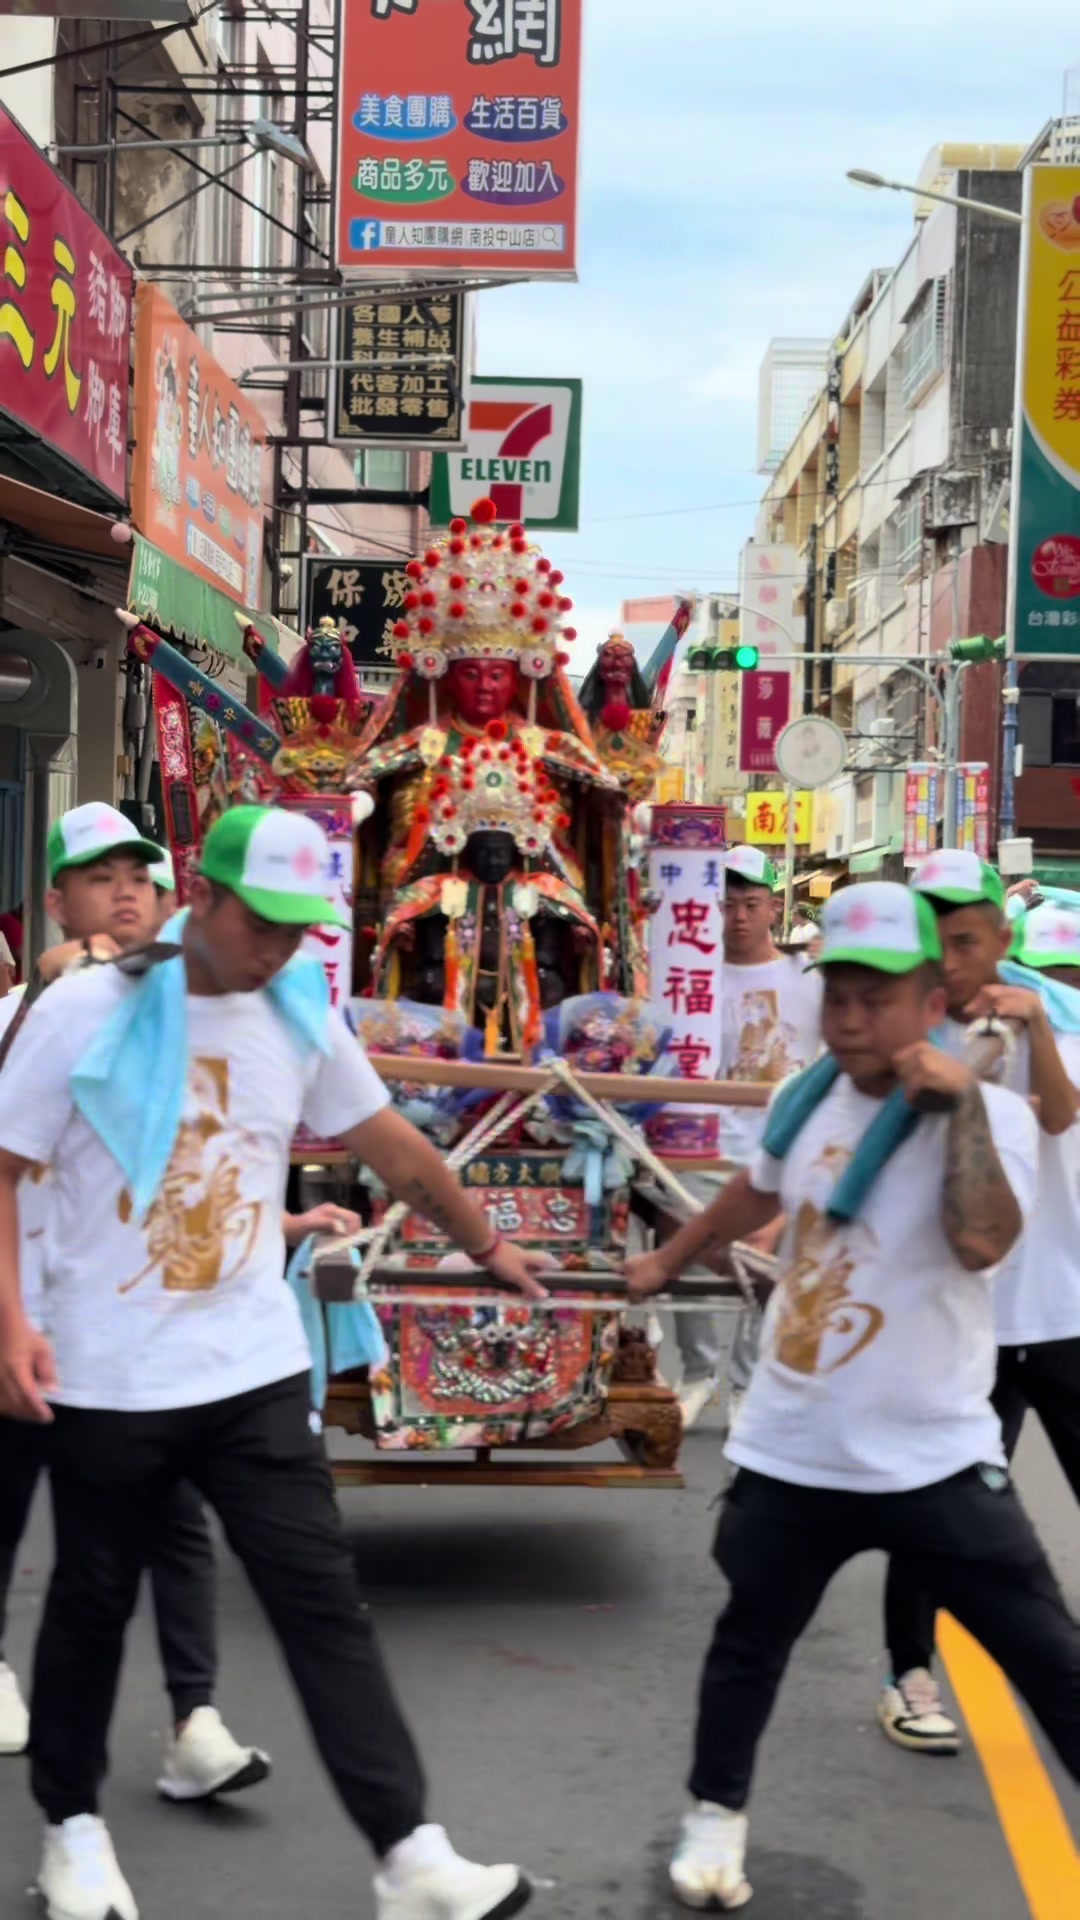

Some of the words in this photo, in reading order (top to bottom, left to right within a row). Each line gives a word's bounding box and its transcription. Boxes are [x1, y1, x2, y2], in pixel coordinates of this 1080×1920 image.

[359, 94, 451, 129] 美食團購
[470, 96, 562, 131] 生活百貨
[357, 158, 449, 191] 商品多元
[468, 159, 559, 193] 歡迎加入
[350, 373, 449, 393] 代客加工
[350, 396, 449, 418] 批發零售
[1027, 610, 1080, 626] 台灣彩
[662, 898, 717, 1081] 忠福堂
